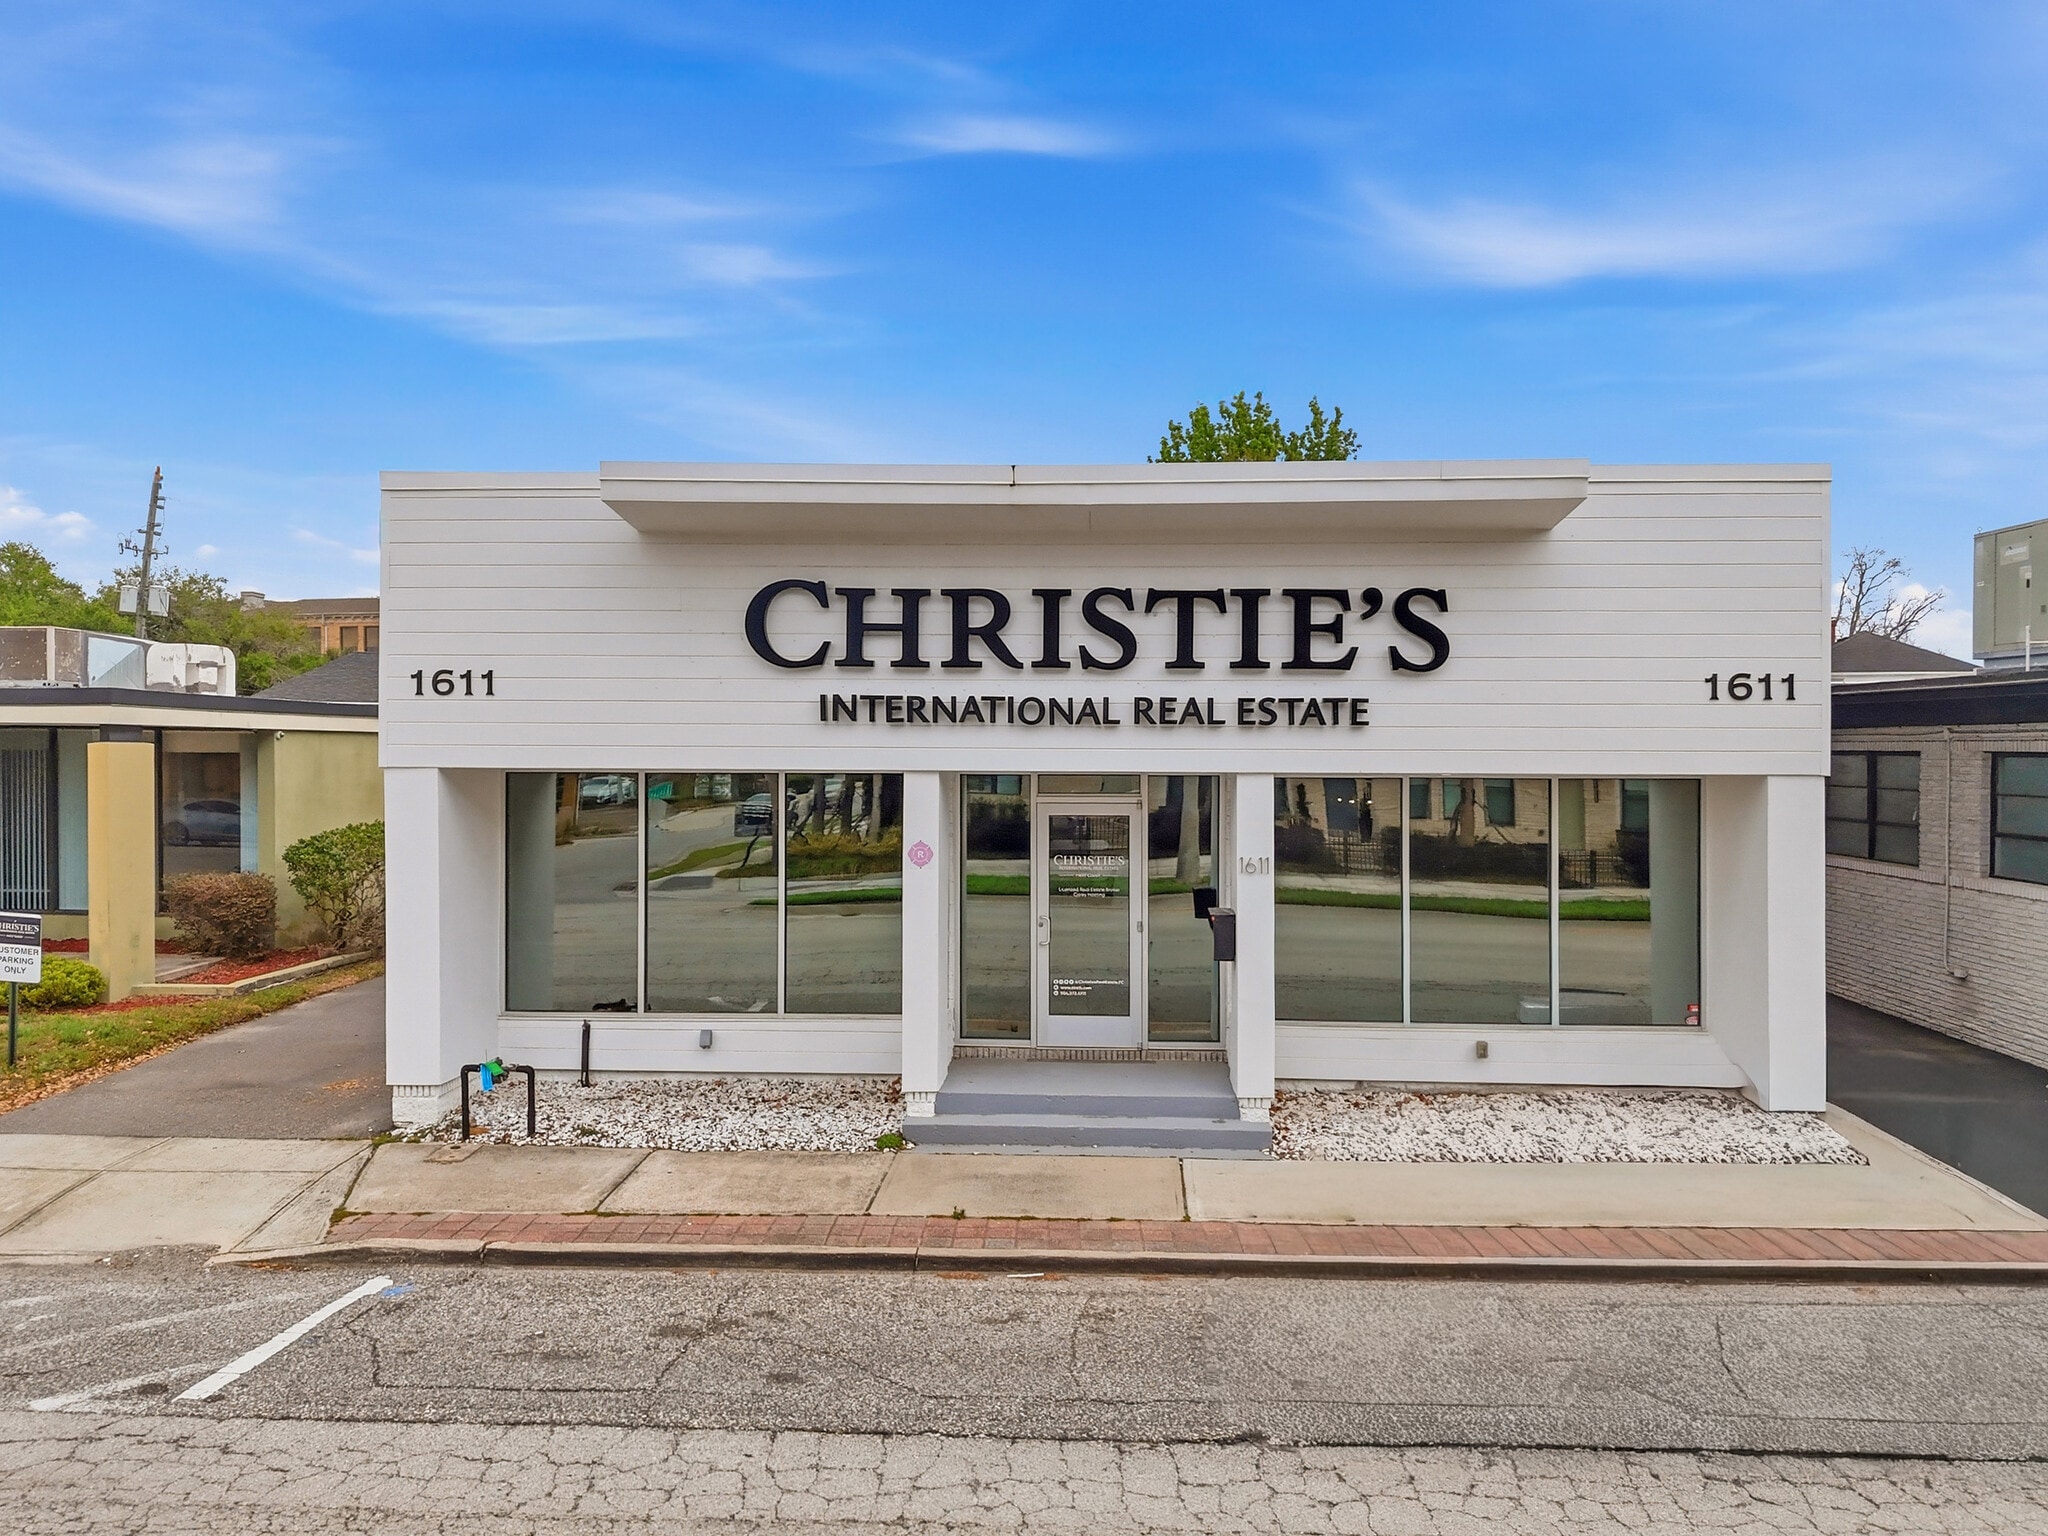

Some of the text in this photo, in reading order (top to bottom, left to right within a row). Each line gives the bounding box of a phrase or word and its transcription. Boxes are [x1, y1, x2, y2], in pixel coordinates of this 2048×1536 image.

[745, 579, 1450, 672] CHRISTIE'S
[410, 669, 494, 696] 1611
[1705, 673, 1796, 701] 1611
[820, 694, 1370, 726] INTERNATIONAL REAL ESTATE
[917, 850, 924, 858] R
[1053, 854, 1125, 866] CHRISTIE'S
[1239, 857, 1270, 874] 1611
[0, 922, 39, 933] HRISTIE'S
[0, 946, 39, 956] USTOMER
[4, 966, 26, 974] ONLY
